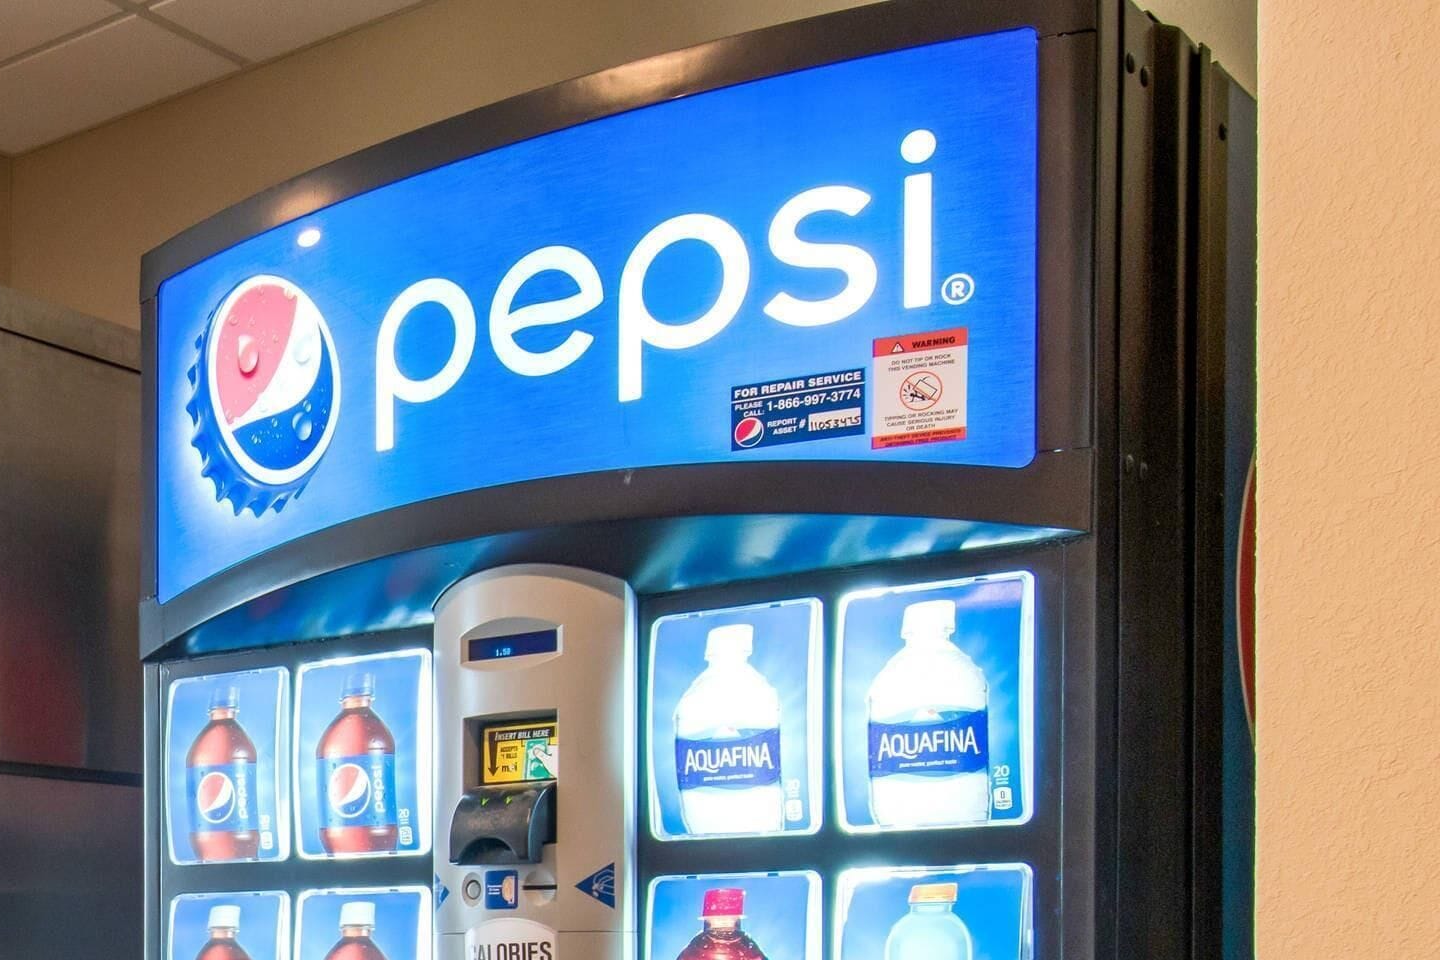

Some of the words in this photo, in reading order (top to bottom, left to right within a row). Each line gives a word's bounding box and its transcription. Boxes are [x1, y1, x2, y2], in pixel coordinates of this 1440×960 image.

[912, 336, 955, 348] WARNING
[929, 359, 955, 367] MACHINE
[734, 387, 758, 399] FOR
[761, 379, 805, 395] REPAIR
[808, 371, 861, 387] SERVICE
[734, 401, 763, 411] PLEASE
[766, 388, 861, 411] 1-866-997-3774
[743, 409, 764, 418] CALL:
[767, 417, 797, 428] REPORT
[799, 419, 806, 429] #
[773, 426, 797, 435] ASSET
[495, 731, 517, 741] INSERT
[517, 730, 531, 739] BILL
[532, 729, 550, 738] HERE
[878, 726, 981, 761] AQUAFINA
[685, 742, 774, 775] AQUAFINA
[993, 765, 1010, 777] 20
[371, 764, 386, 812] pepsi
